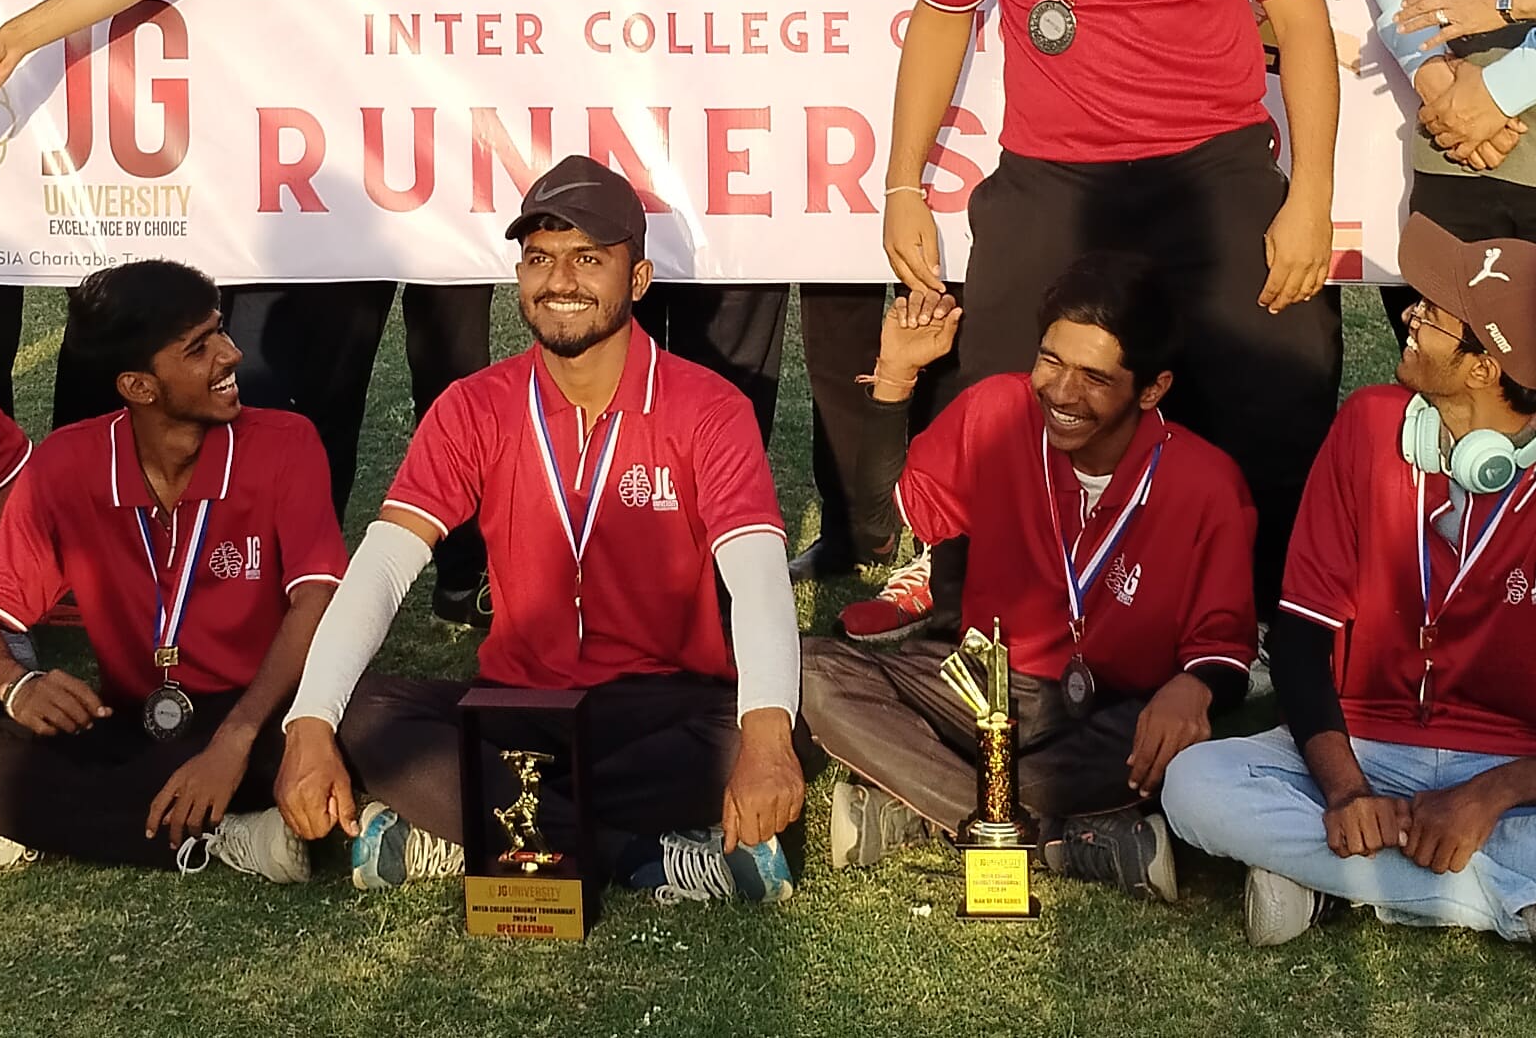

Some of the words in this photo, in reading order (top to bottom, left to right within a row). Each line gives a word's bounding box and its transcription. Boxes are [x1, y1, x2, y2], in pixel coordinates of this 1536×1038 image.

[364, 12, 544, 56] INTER
[584, 10, 851, 54] COLLEGE
[256, 105, 987, 214] RUNNERS
[125, 220, 142, 236] BY
[144, 220, 188, 236] CHOICE
[1485, 322, 1512, 353] PUMA
[245, 536, 261, 570] JG
